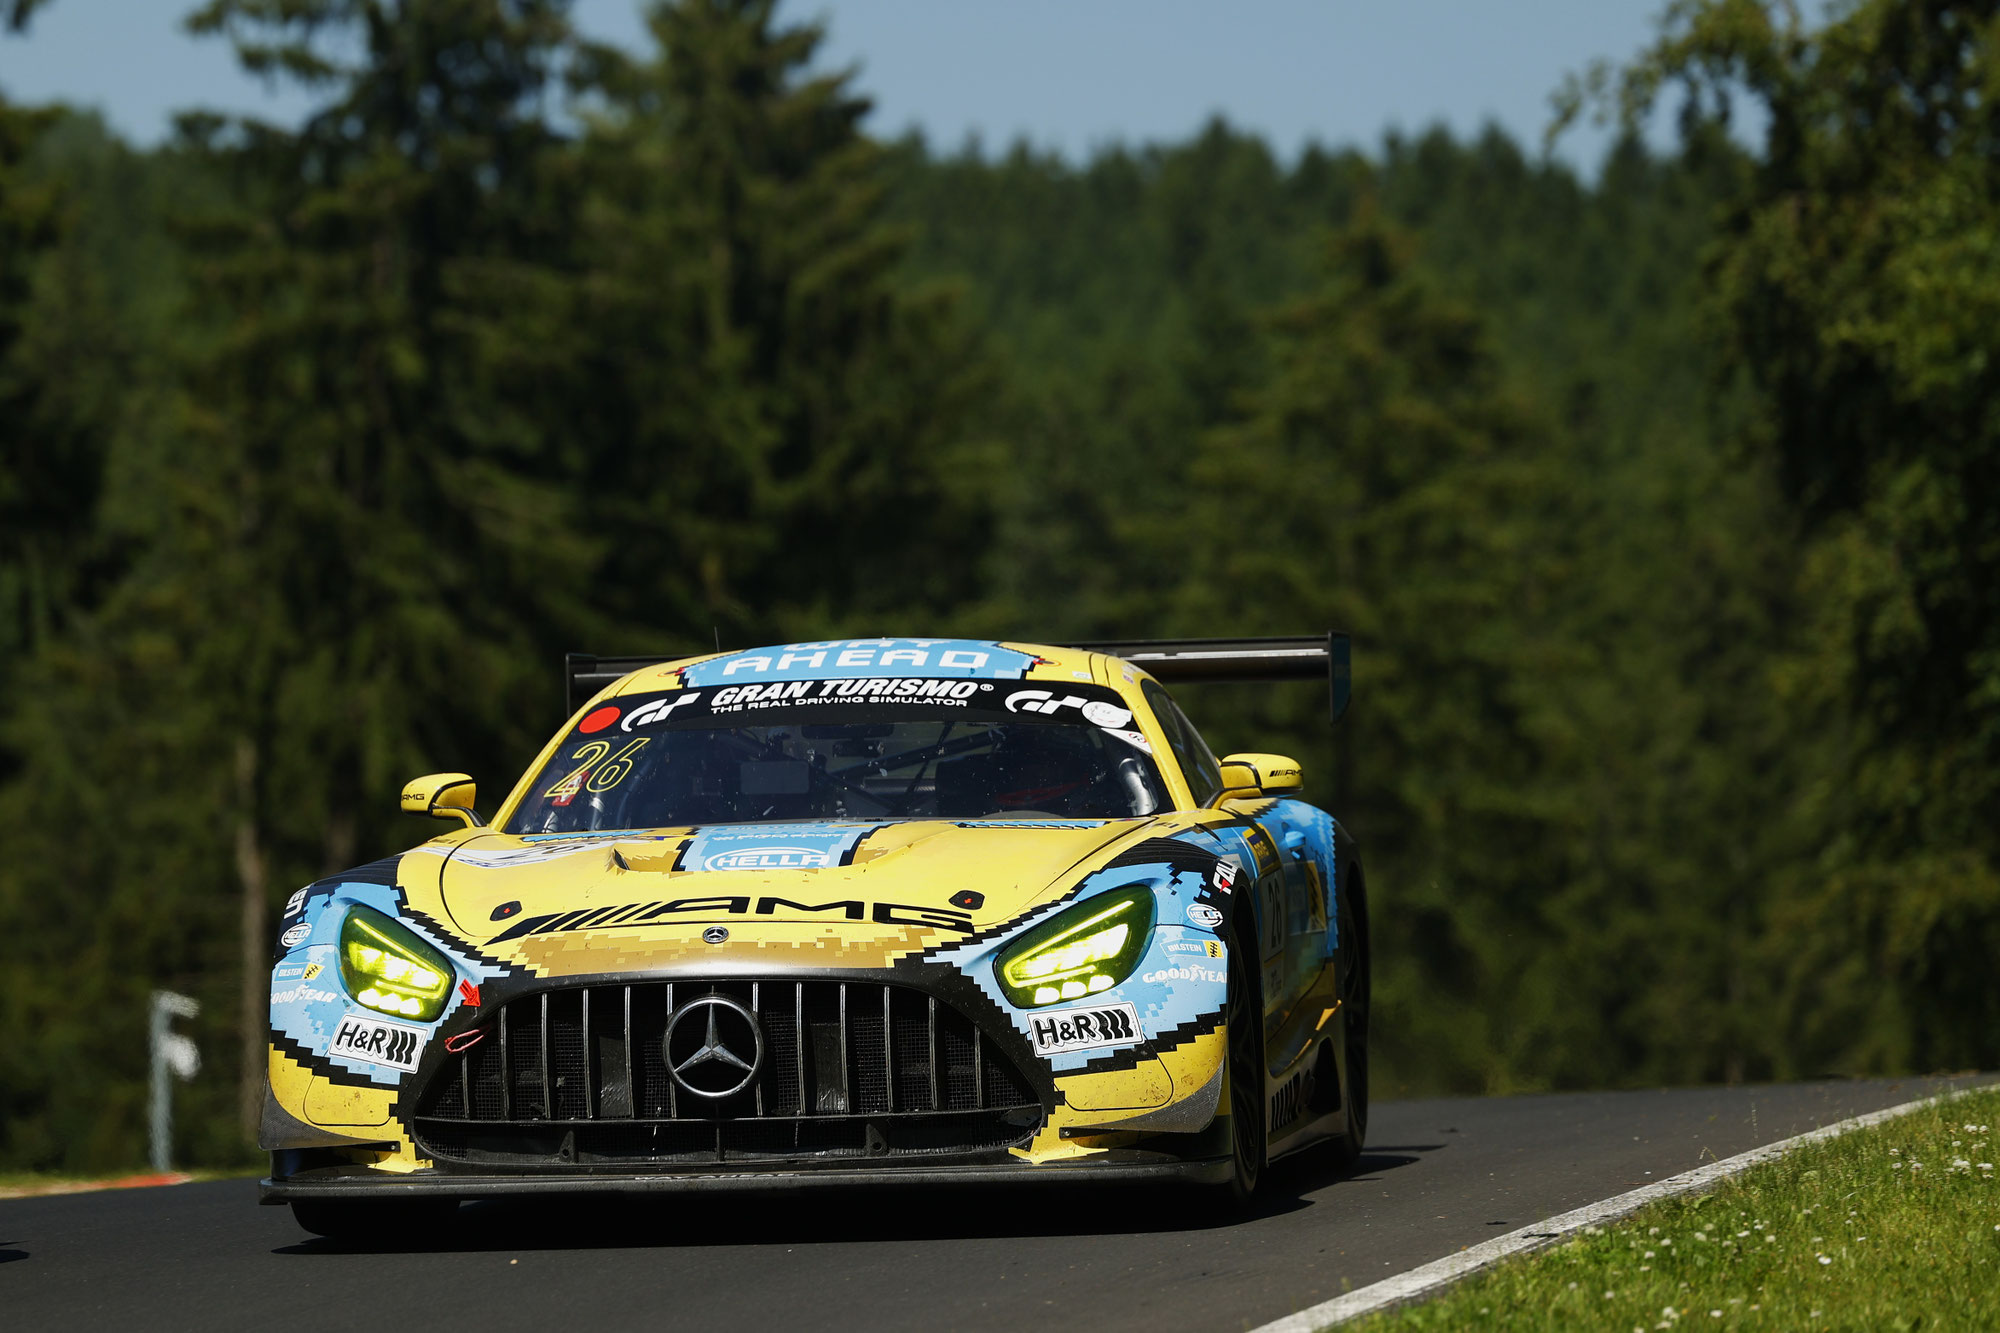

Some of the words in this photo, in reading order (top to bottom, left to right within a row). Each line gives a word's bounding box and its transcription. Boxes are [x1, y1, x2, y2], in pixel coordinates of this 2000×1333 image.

[723, 649, 990, 676] AHEAD
[711, 681, 814, 707] GRAN
[711, 705, 742, 715] THE
[748, 701, 790, 710] REAL
[795, 697, 864, 706] DRIVING
[869, 696, 968, 707] SIMULATOR
[543, 737, 651, 798] 26
[717, 854, 830, 867] HELLA
[636, 896, 974, 938] AMG
[1190, 909, 1223, 920] HELLA
[284, 928, 312, 940] HELLA
[1167, 943, 1203, 953] BILSTEIN
[278, 967, 304, 977] BILSTEIN
[271, 985, 337, 1004] OODYEAR
[336, 1022, 388, 1054] H&R
[1034, 1015, 1097, 1045] H&R
